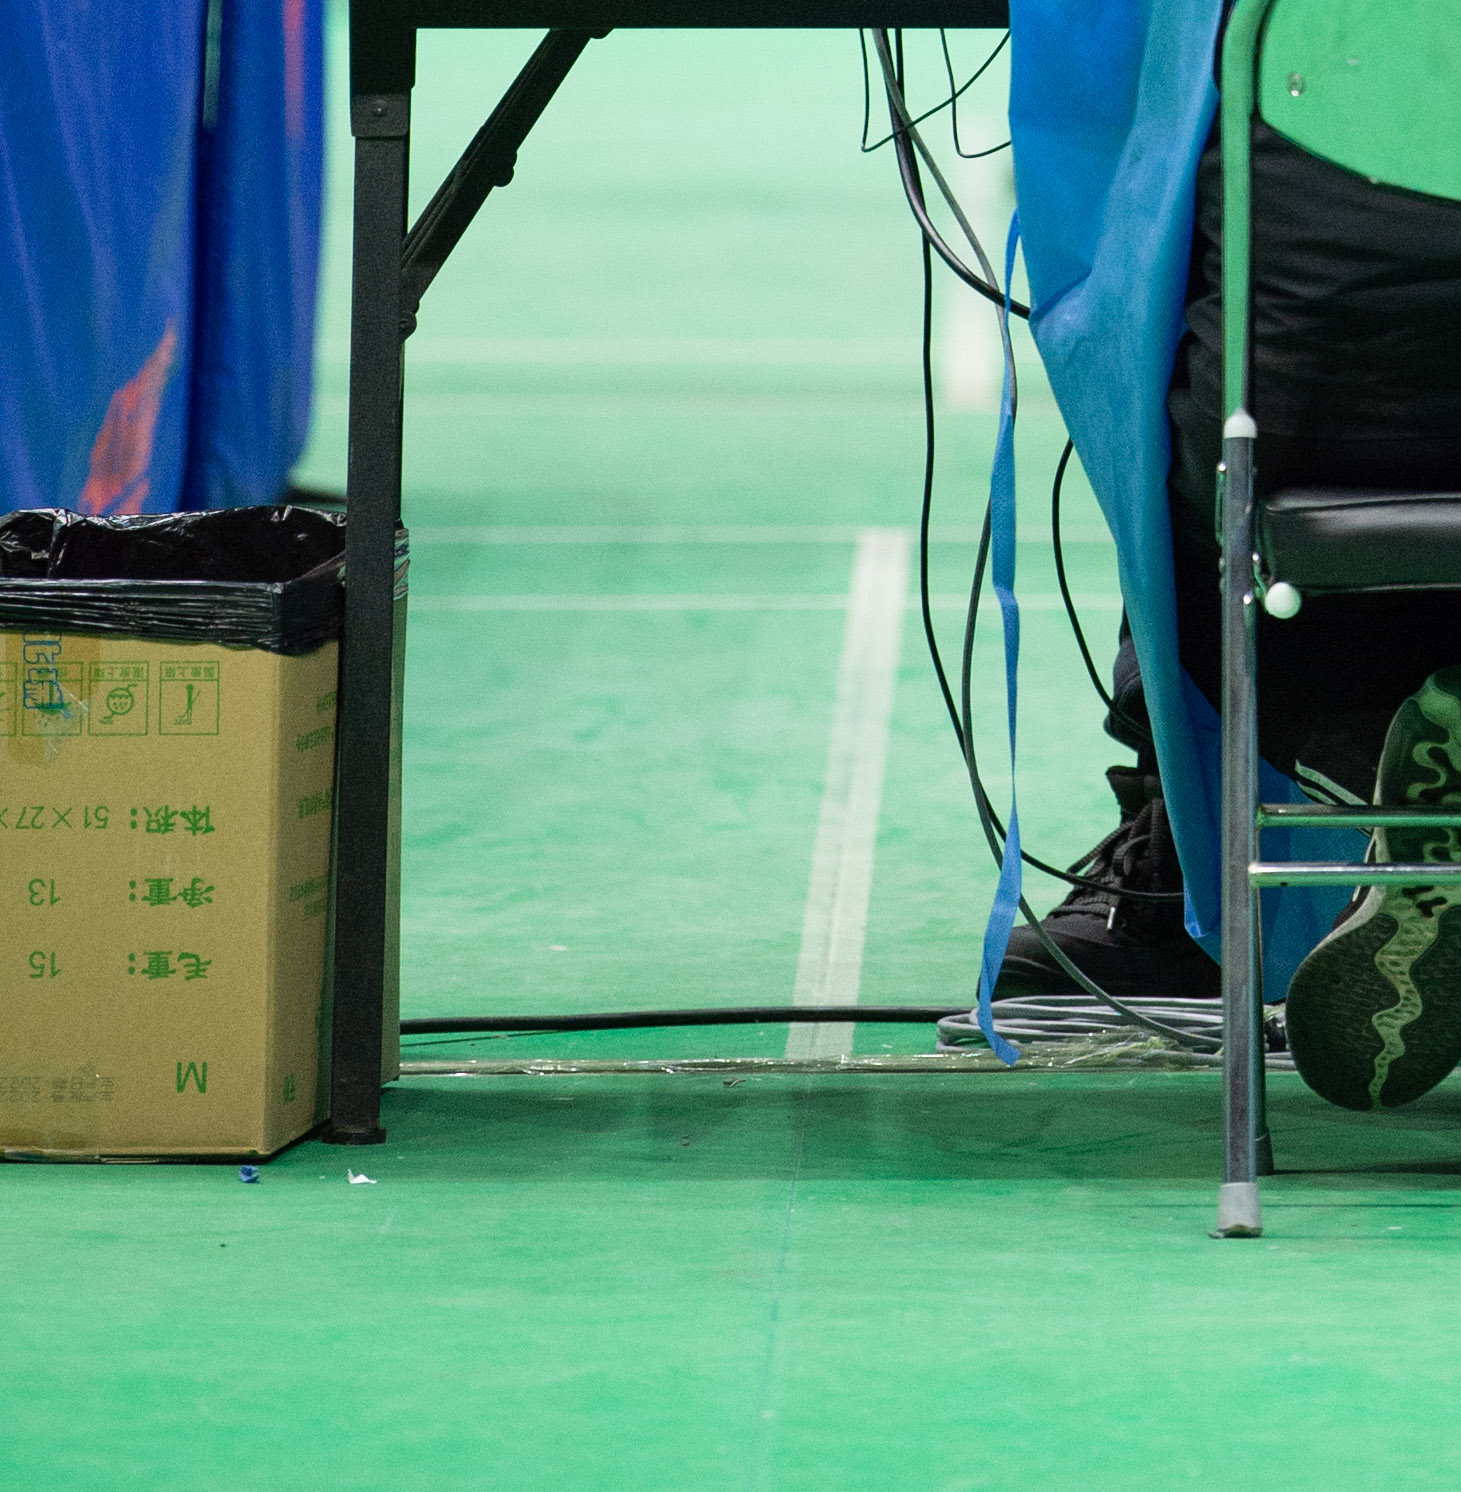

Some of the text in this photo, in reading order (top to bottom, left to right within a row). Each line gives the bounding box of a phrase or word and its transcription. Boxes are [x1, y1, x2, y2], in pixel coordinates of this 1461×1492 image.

[28, 877, 62, 906] 13
[28, 951, 62, 979] 15
[176, 1061, 208, 1094] M
